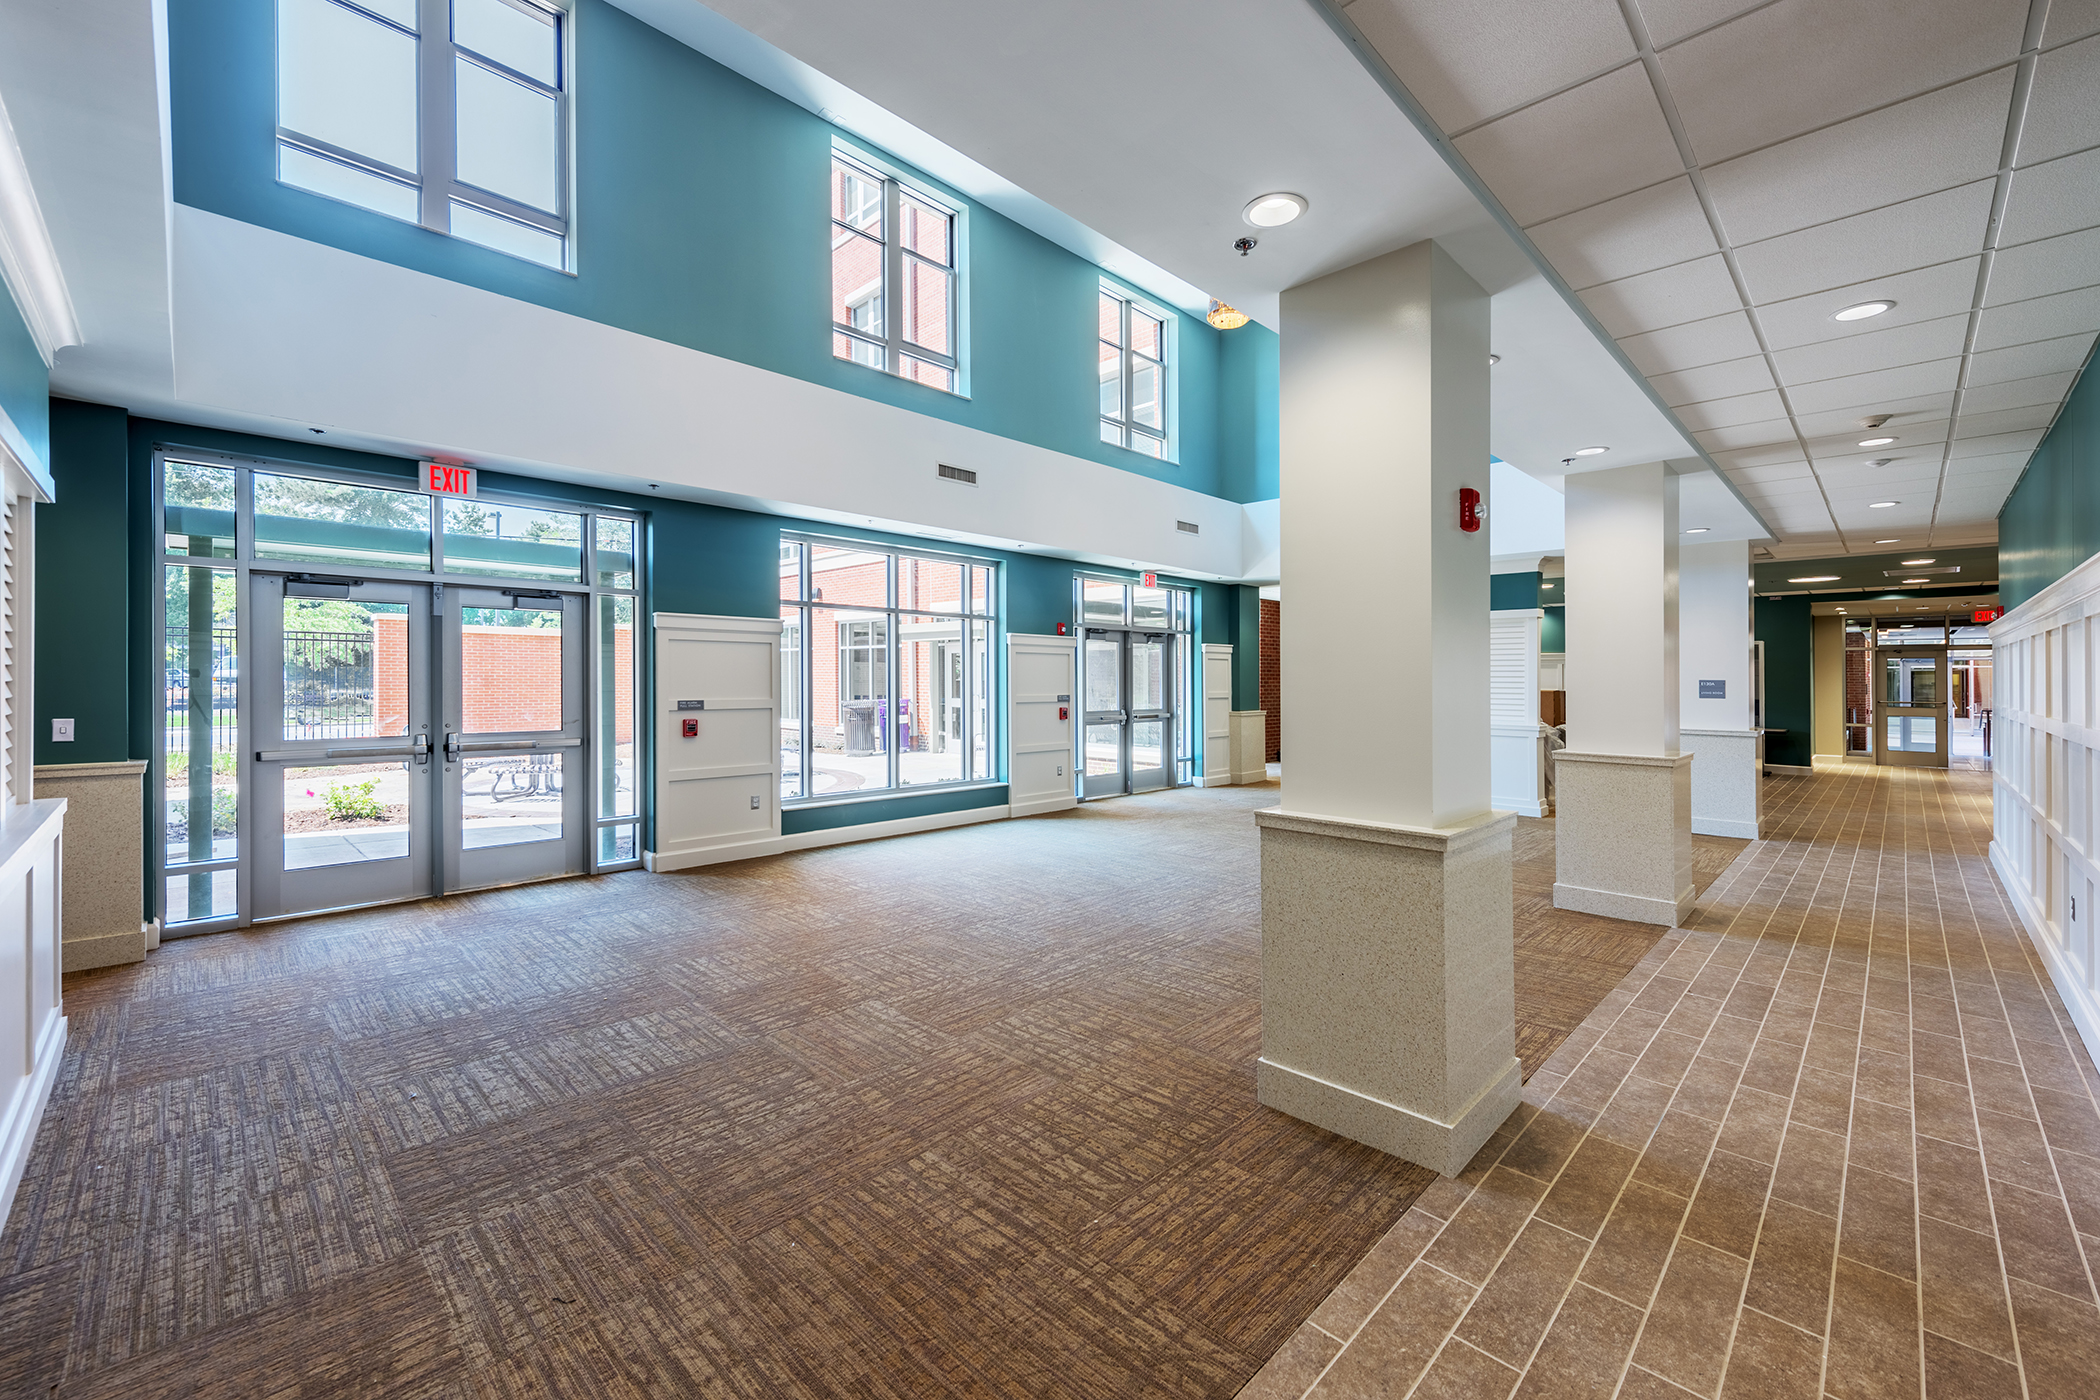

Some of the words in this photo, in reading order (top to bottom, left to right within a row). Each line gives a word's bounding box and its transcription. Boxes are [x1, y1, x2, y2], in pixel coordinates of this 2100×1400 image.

[429, 464, 470, 495] EXIT
[1145, 573, 1156, 587] EXIT
[1974, 610, 1995, 621] EXIT
